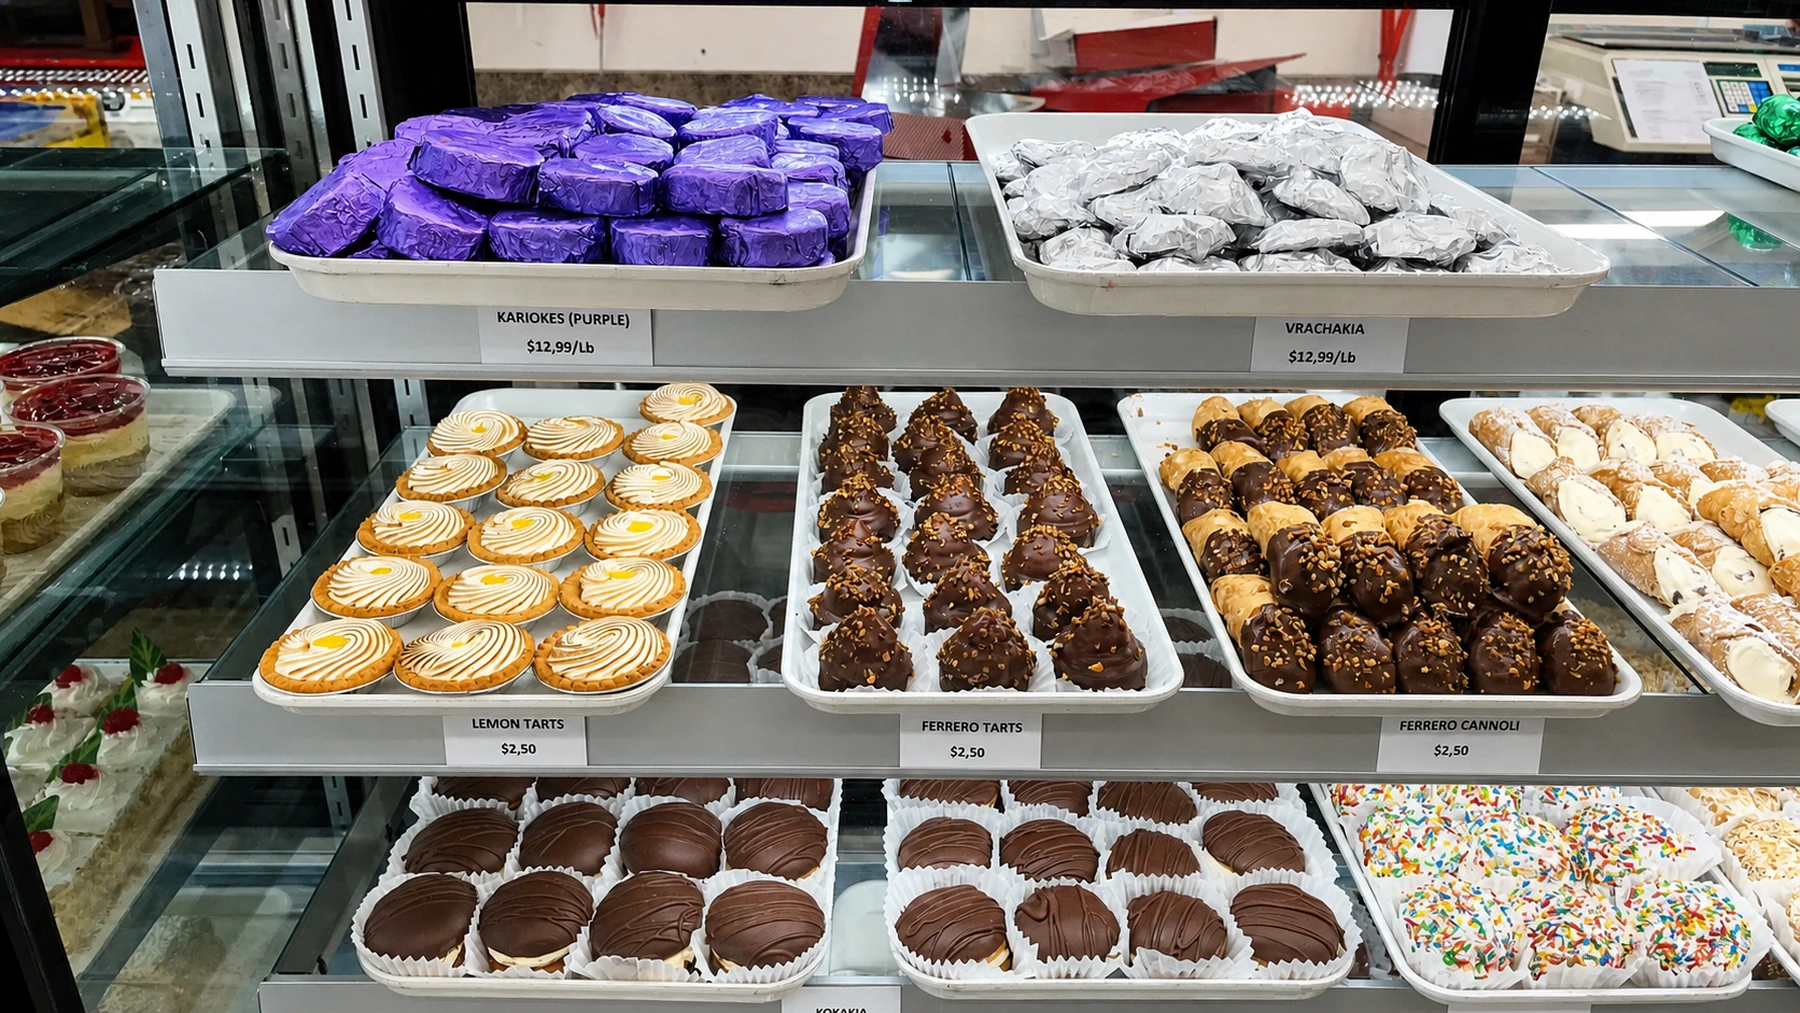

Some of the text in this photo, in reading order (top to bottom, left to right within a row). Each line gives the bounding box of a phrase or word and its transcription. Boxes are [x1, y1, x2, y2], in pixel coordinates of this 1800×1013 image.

[497, 311, 630, 329] KARIOKES (PURPLE)
[1285, 322, 1365, 335] VRACHAKIA
[526, 339, 595, 356] $12,99/Lb
[1288, 349, 1356, 365] $12,99/Lb
[472, 718, 565, 730] LEMON TARTS
[922, 721, 1023, 733] FERRERO TARTS
[1400, 720, 1520, 731] FERRERO CANNOLI
[501, 743, 537, 756] $2,50
[950, 745, 985, 759] $2,50
[1433, 744, 1469, 757] $2,50
